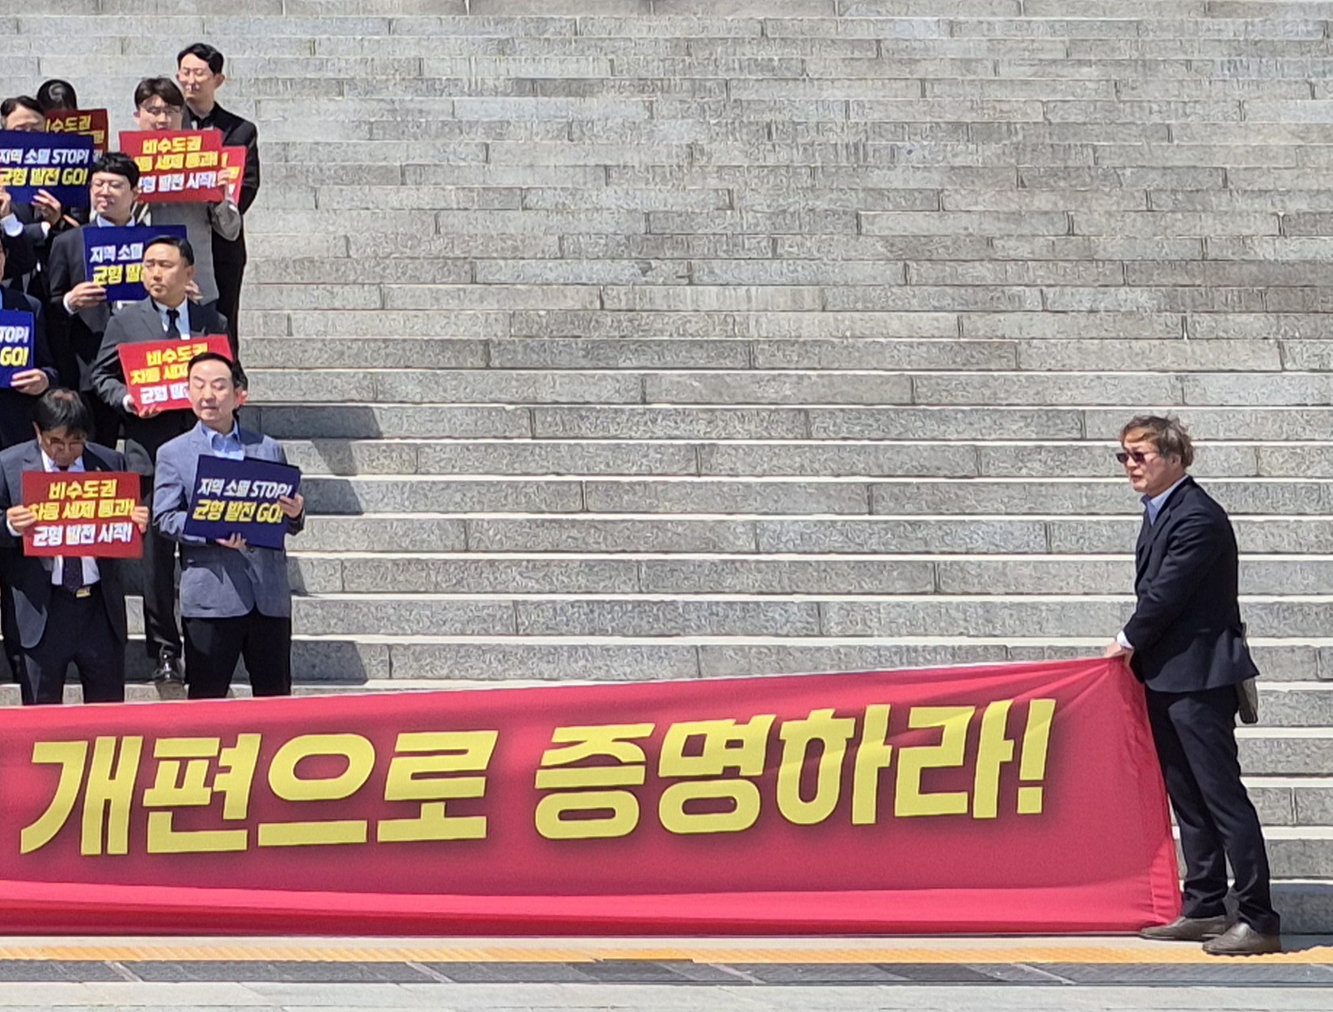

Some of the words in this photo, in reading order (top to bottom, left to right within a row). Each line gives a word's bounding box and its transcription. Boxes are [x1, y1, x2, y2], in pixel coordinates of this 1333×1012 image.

[24, 149, 50, 164] 소멸
[52, 150, 89, 163] STOP!
[0, 170, 27, 186] 균형
[32, 169, 59, 185] 발전
[62, 168, 88, 185] GO!
[1, 349, 27, 366] GO!
[49, 480, 117, 499] 비수도권
[198, 479, 224, 495] 지역
[224, 480, 251, 496] 소멸
[62, 501, 96, 519] 세제
[195, 501, 225, 520] 균형
[226, 503, 256, 521] 발전
[33, 526, 63, 546] 균형
[66, 524, 95, 545] 발전
[98, 522, 132, 542] 시작!
[21, 732, 495, 855] 개편으로
[535, 700, 1055, 839] 증명하라!
